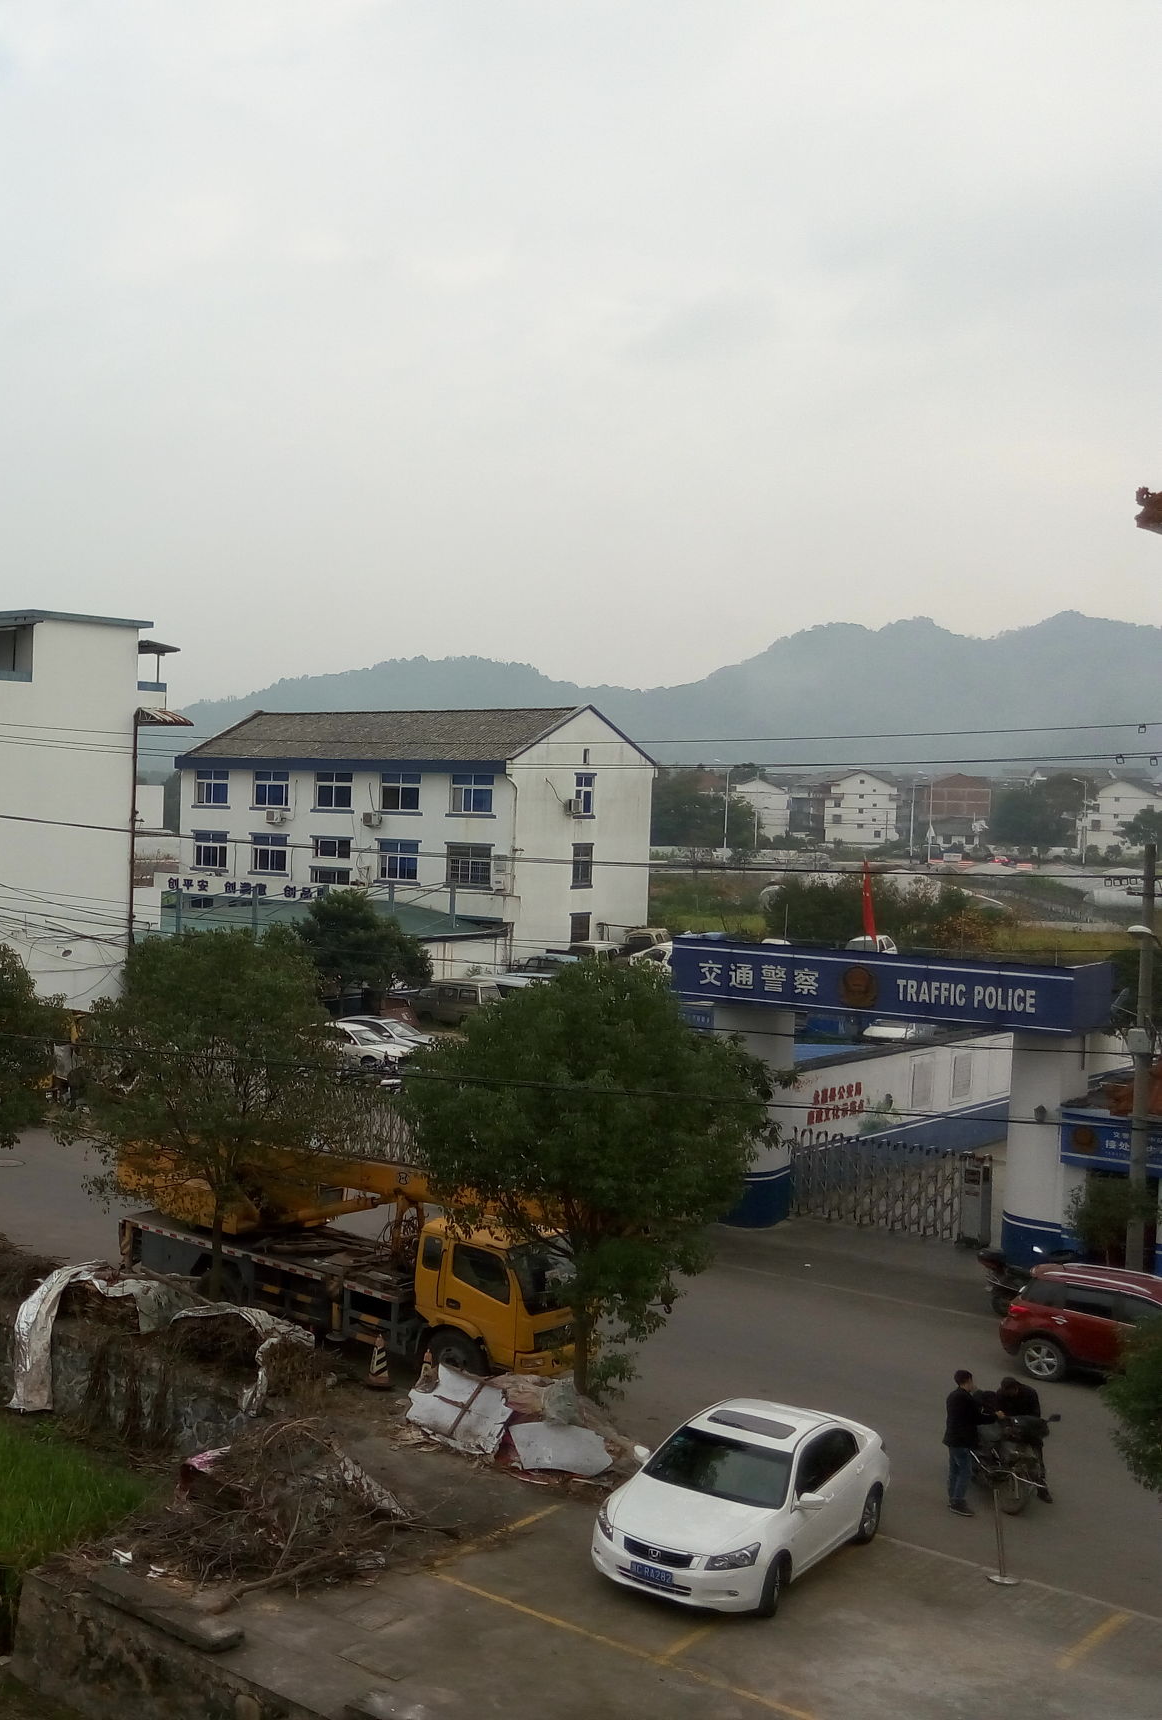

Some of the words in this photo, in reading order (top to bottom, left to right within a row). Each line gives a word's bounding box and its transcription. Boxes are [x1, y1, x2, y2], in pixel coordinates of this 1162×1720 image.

[168, 877, 208, 892] 创平安
[698, 960, 819, 996] 交通警察
[896, 979, 966, 1007] TRAFFIC
[973, 985, 1036, 1013] POLICE
